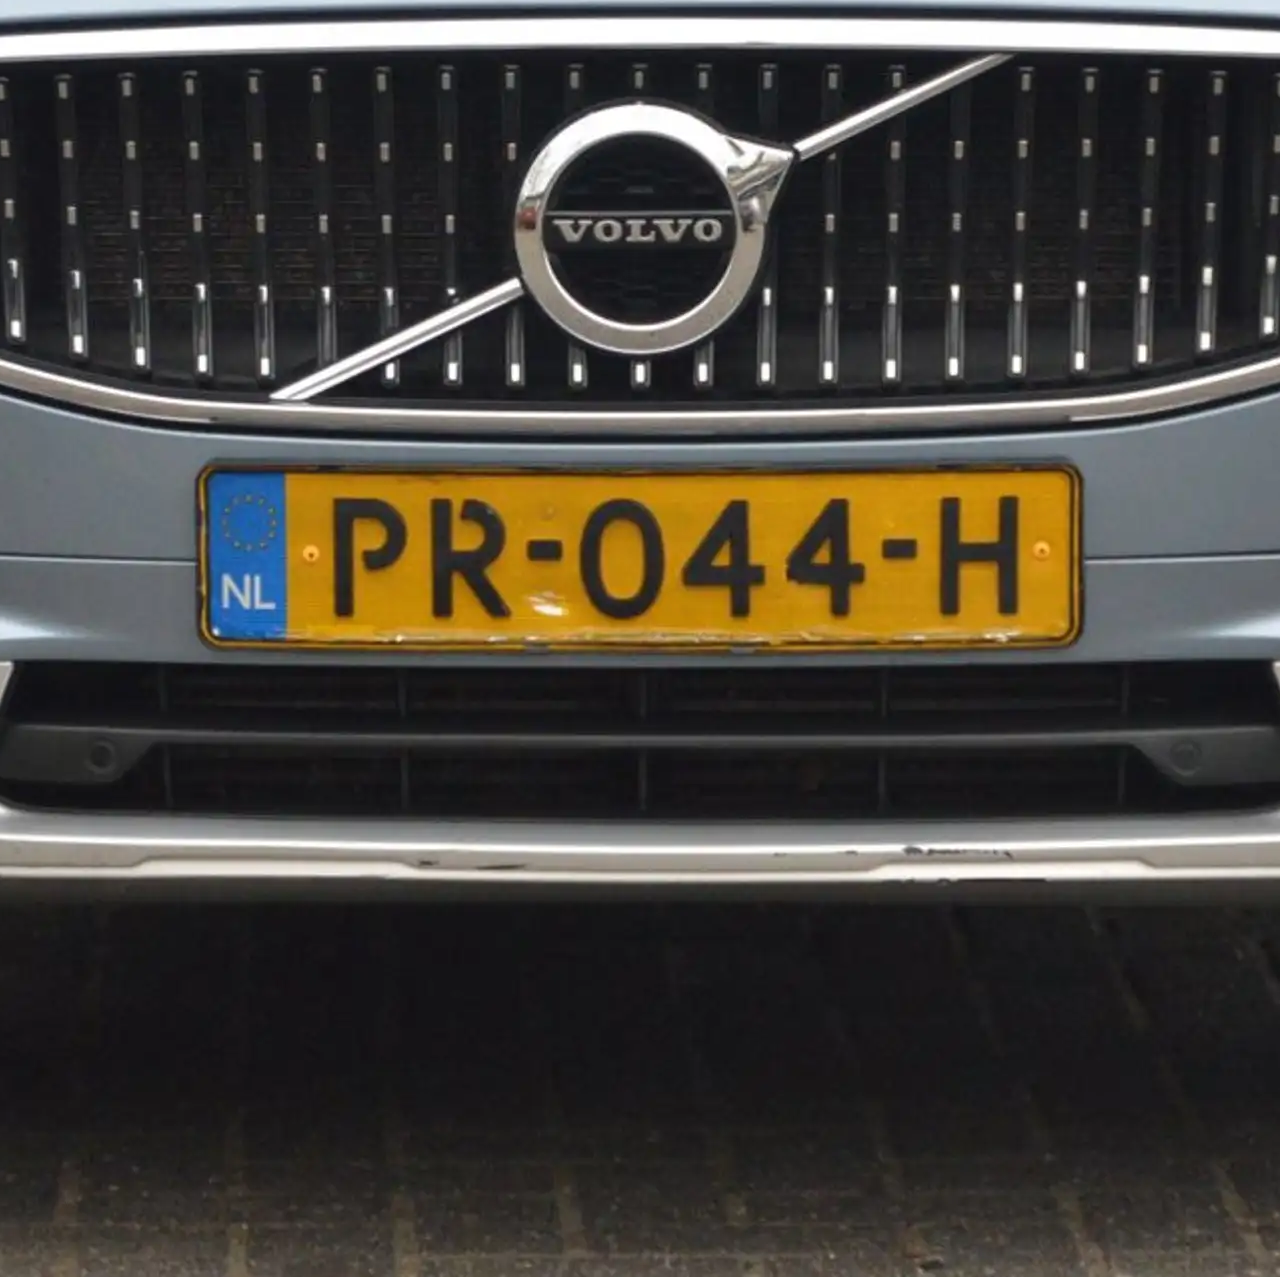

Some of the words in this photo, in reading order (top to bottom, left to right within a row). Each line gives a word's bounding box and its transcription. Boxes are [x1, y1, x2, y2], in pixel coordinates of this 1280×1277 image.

[552, 218, 722, 242] VOLVO
[333, 496, 1020, 619] PR-044-H
[221, 573, 277, 610] NL
